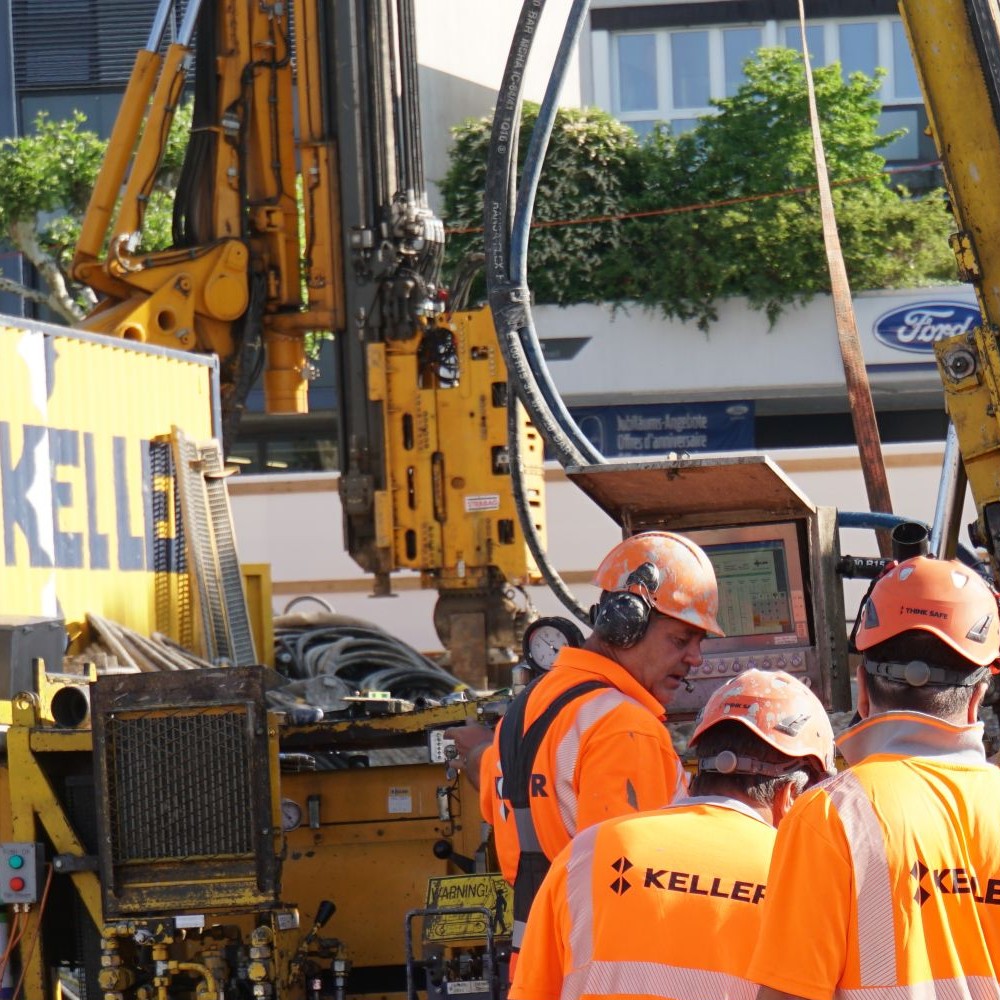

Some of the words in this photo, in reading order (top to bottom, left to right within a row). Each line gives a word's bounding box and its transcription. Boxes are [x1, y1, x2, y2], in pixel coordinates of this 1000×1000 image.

[523, 11, 538, 33] BAR
[514, 39, 530, 69] MSHA
[897, 309, 973, 343] Ford
[906, 607, 928, 616] THINK
[929, 609, 949, 620] SAFE
